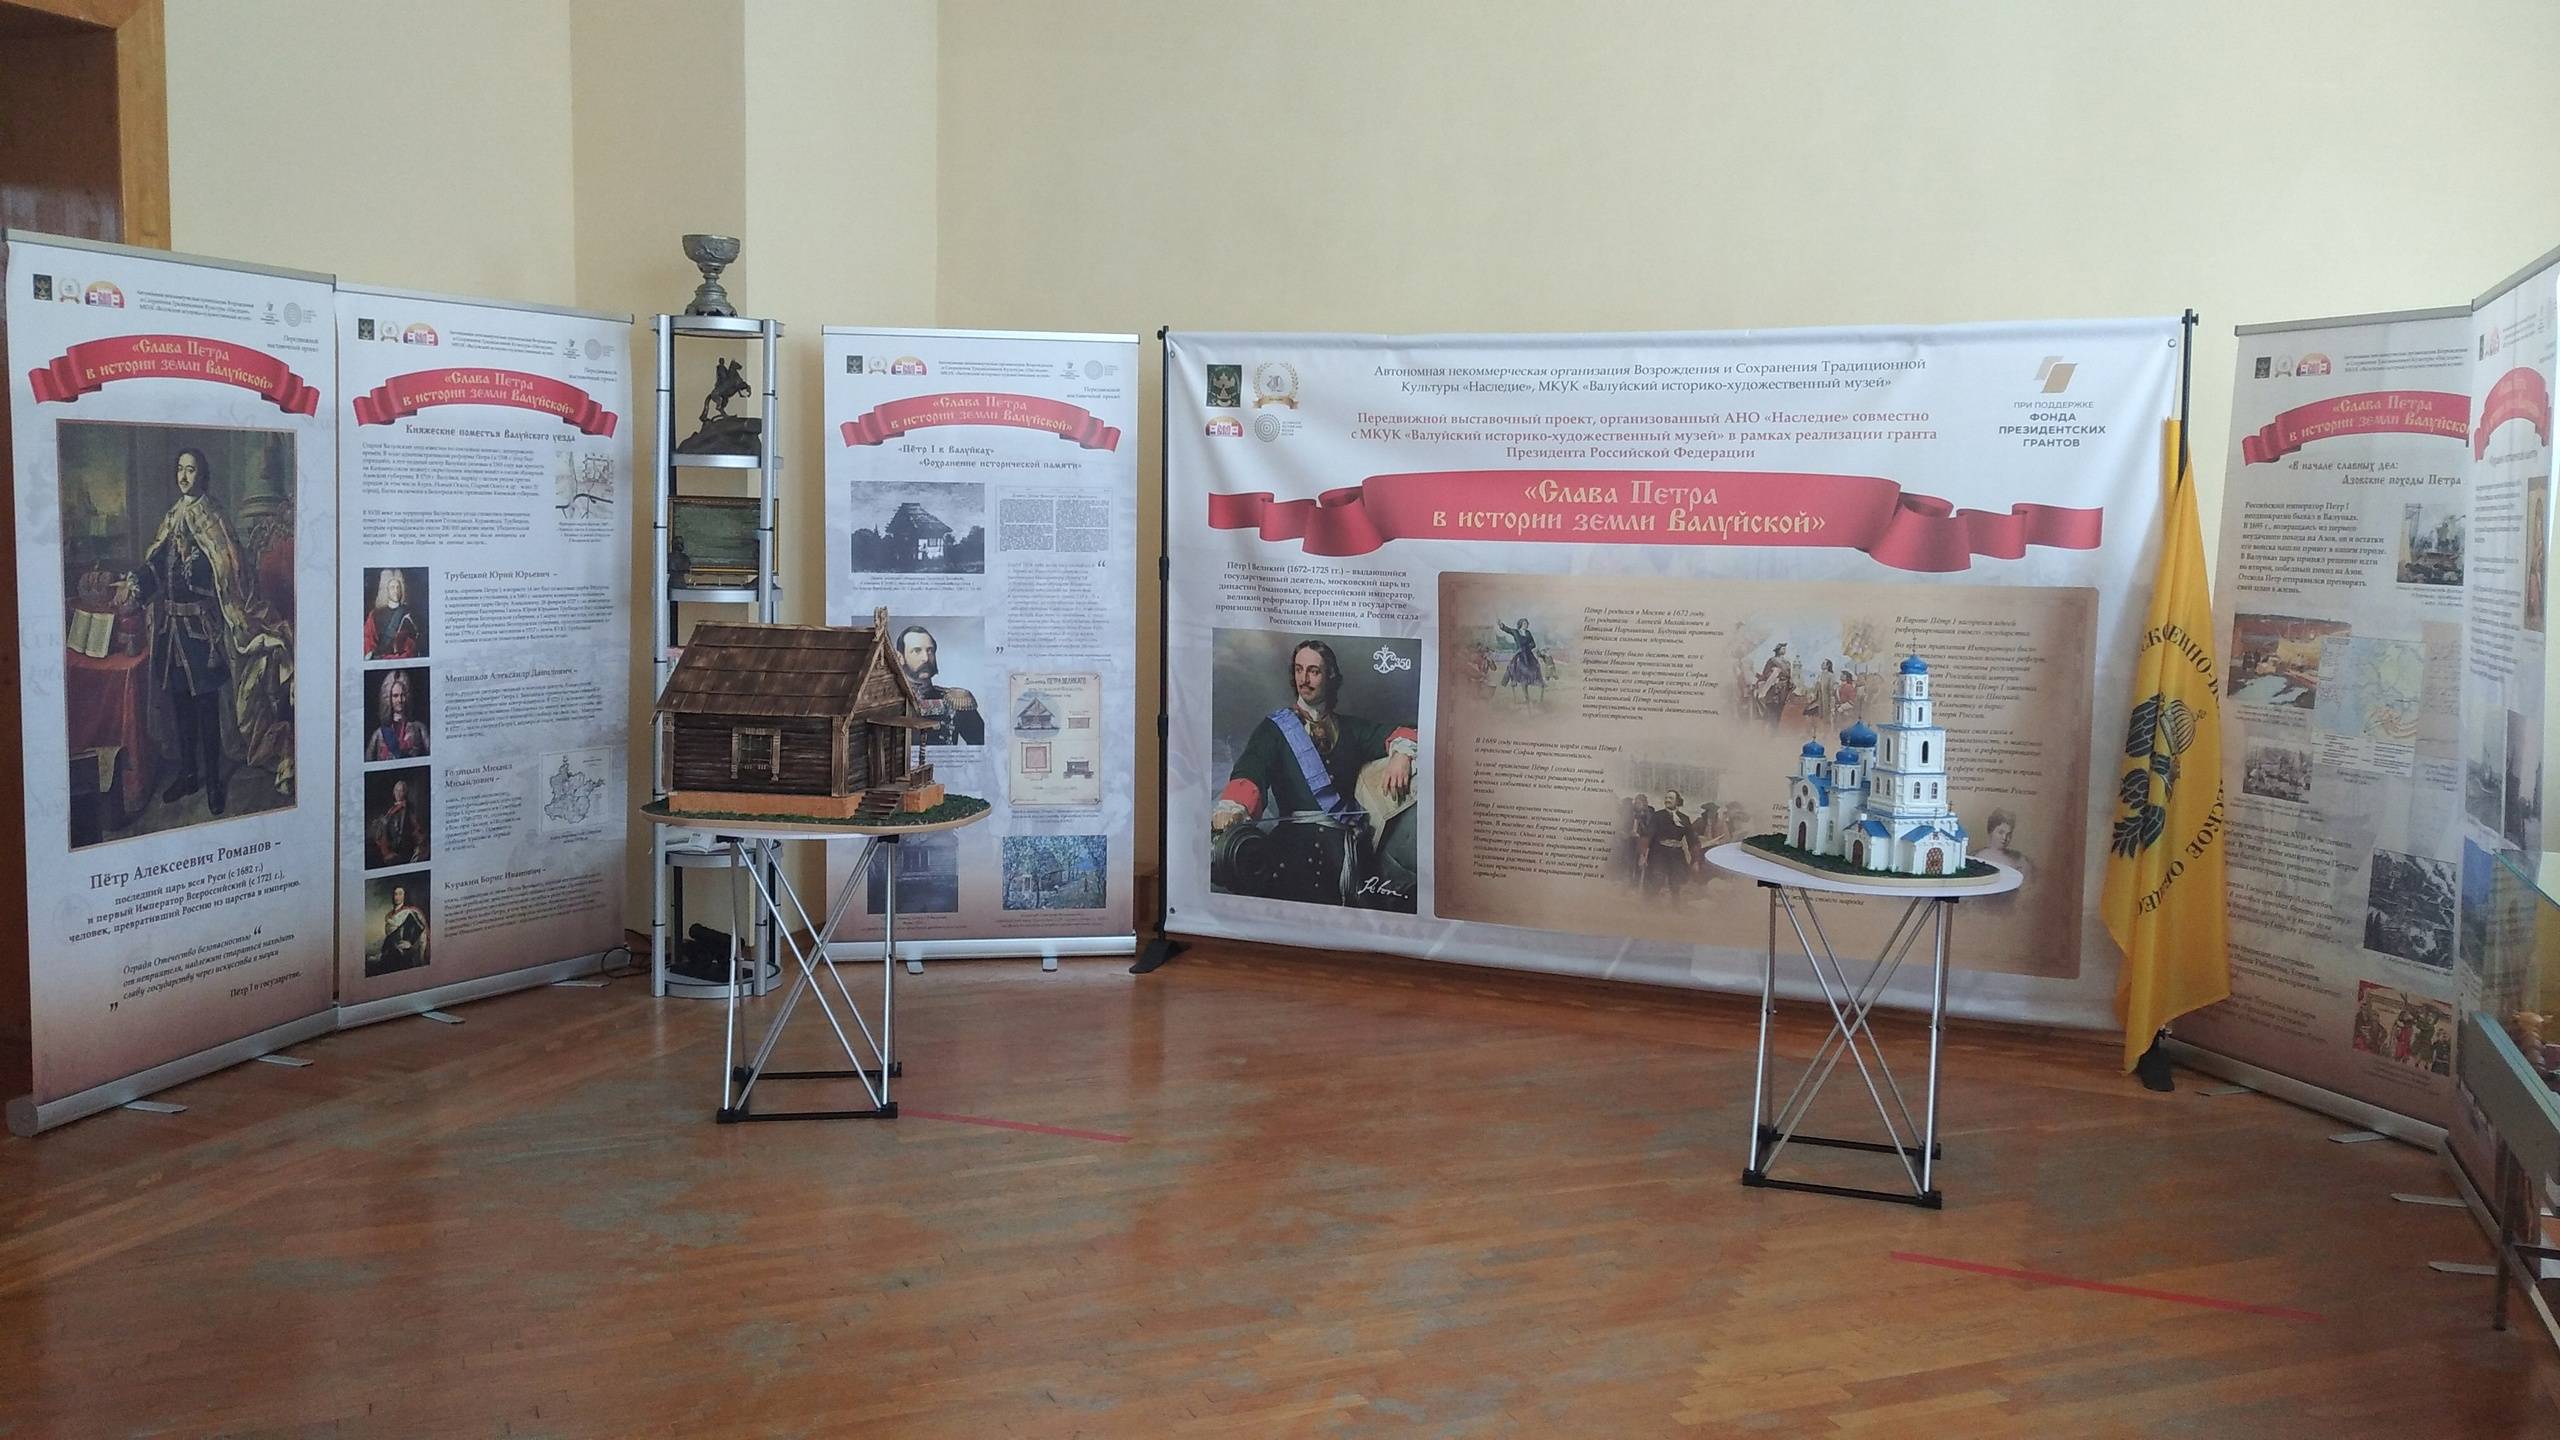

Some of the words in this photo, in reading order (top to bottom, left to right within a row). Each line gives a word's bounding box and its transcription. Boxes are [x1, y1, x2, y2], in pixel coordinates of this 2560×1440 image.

[132, 339, 181, 354] «Слава
[188, 341, 229, 362] Петра
[86, 368, 96, 380] в
[101, 360, 156, 376] истории
[161, 360, 200, 372] земли
[206, 361, 273, 390] Валуйской»
[1374, 366, 1445, 378] Автономная
[1449, 366, 1547, 380] некоммерческая
[1550, 366, 1631, 378] организация
[1634, 364, 1720, 378] Возрождения
[1724, 366, 1732, 374] и
[1736, 363, 1817, 378] Сохранения
[1822, 359, 1927, 374] Традиционной
[445, 372, 490, 385] «Слава
[495, 373, 534, 391] Петра
[1401, 382, 1459, 394] Культуры
[1463, 382, 1535, 394] «Наследие»,
[1539, 382, 1579, 392] МКУК
[1582, 380, 1657, 394] «Валуйский
[1661, 378, 1840, 394] историко-художественный
[1844, 376, 1892, 392] музей»
[403, 396, 411, 406] в
[415, 388, 466, 403] истории
[470, 389, 507, 399] земли
[511, 390, 575, 414] Валуйской»
[933, 398, 979, 408] «Слава
[986, 397, 1027, 411] Петра
[2035, 401, 2094, 409] ПОДДЕРЖКЕ
[2333, 400, 2381, 412] «Слава
[2388, 395, 2432, 411] Петра
[891, 421, 899, 429] в
[904, 413, 954, 424] истории
[960, 411, 998, 420] земли
[1003, 410, 1073, 432] Валуйской»
[1358, 413, 1445, 425] Передвижной
[1451, 414, 1541, 425] выставочный
[1545, 415, 1596, 426] проект,
[1600, 412, 1719, 427] организованный
[1724, 412, 1760, 424] АНО
[1764, 411, 1849, 425] «Наследие»
[1852, 412, 1929, 423] совместно
[2030, 413, 2076, 422] ФОНДА
[406, 424, 455, 435] Княжеские
[459, 429, 500, 438] поместья
[504, 430, 549, 442] Валуйского
[1999, 426, 2106, 435] ПРЕЗИДЕНТСКИХ
[2289, 432, 2297, 441] в
[2302, 419, 2353, 437] истории
[2359, 415, 2399, 427] земли
[2405, 413, 2469, 434] Валуйско
[1351, 431, 1357, 439] с
[1361, 429, 1401, 441] МКУК
[1404, 430, 1481, 442] «Валуйский
[1485, 430, 1670, 444] историко-художественный
[1675, 430, 1724, 443] музей»
[1728, 431, 1736, 440] в
[1741, 431, 1791, 443] рамках
[1796, 430, 1882, 443] реализации
[1888, 430, 1937, 442] гранта
[2023, 439, 2080, 447] ГРАНТОВ
[898, 444, 927, 454] «Пётр
[931, 445, 935, 453] I
[949, 446, 994, 455] Валуйках»
[1506, 447, 1586, 459] Президента
[1590, 447, 1670, 460] Российской
[1674, 448, 1755, 461] Федерации
[919, 458, 976, 469] «Сохранение
[980, 460, 1040, 469] исторической
[2302, 463, 2332, 471] начале
[2337, 462, 2376, 473] славных
[2378, 463, 2398, 472] дел:
[2342, 476, 2385, 485] Азовские
[2389, 477, 2423, 486] походы
[2429, 475, 2461, 486] Петра
[1524, 479, 1618, 504] «Слава
[1631, 480, 1718, 511] Петра
[1432, 510, 1447, 528] в
[1458, 513, 1562, 535] истории
[1573, 513, 1655, 532] земли
[1666, 508, 1825, 540] Валуйской»
[445, 571, 487, 581] Трубецкой
[489, 571, 514, 580] Юрий
[515, 570, 550, 580] Юрьевич
[1227, 562, 1247, 571] Пётр
[1252, 564, 1285, 572] Великий
[1352, 569, 1407, 577] выдающийся
[1224, 573, 1288, 583] государственный
[1290, 577, 1325, 585] деятель,
[1328, 579, 1377, 587] московский
[1380, 581, 1399, 589] царь
[1258, 585, 1301, 595] Романовых,
[1303, 588, 1366, 597] всероссийский
[1368, 591, 1415, 600] император,
[1216, 604, 1262, 612] произошли
[1264, 606, 1307, 615] глобальные
[1309, 610, 1358, 618] изменения,
[1263, 597, 1310, 607] реформатор.
[1313, 598, 1330, 607] При
[1359, 602, 1407, 610] государстве
[1269, 616, 1312, 626] Российской
[1314, 620, 1360, 629] Империей.
[89, 873, 129, 890] Пётр
[134, 852, 214, 881] Алексеевич
[218, 841, 272, 862] Романов
[115, 887, 164, 906] последний
[166, 882, 186, 895] царь
[188, 878, 205, 888] всея
[207, 872, 226, 884] Руси
[228, 870, 235, 881] (с
[236, 865, 254, 877] 1682
[255, 863, 264, 874] г.)
[87, 917, 94, 925] и
[97, 907, 134, 924] первый
[135, 894, 184, 913] Император
[186, 880, 247, 901] Всероссийский
[249, 877, 256, 887] (с
[257, 873, 273, 885] 1721
[274, 870, 285, 882] г.),
[69, 927, 111, 943] человек,
[114, 909, 181, 934] превративший
[182, 902, 212, 917] Россию
[214, 900, 224, 908] из
[225, 892, 256, 906] царства
[264, 880, 301, 895] империю.
[123, 963, 152, 975] Оградя
